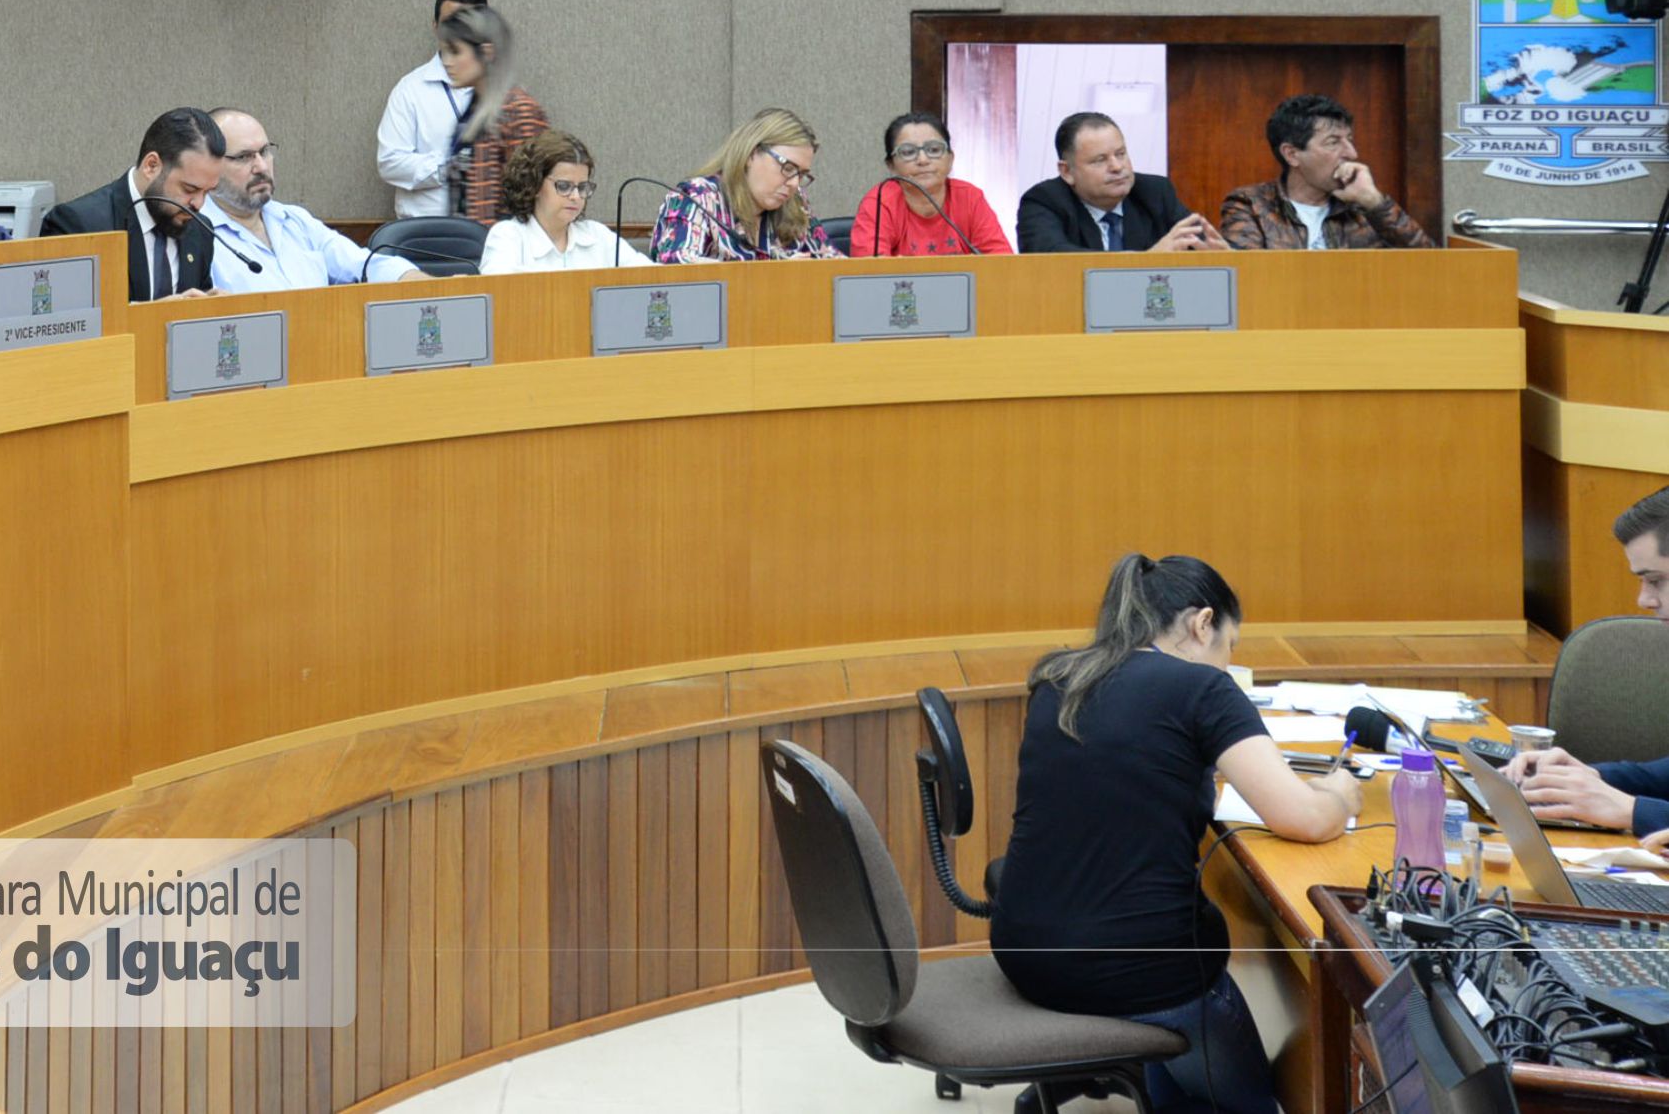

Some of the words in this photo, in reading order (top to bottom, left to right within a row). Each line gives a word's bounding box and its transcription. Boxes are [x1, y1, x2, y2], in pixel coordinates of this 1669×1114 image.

[1483, 109, 1523, 122] FOZ
[1531, 109, 1560, 122] DO
[1567, 109, 1651, 126] IGUAÇU
[1480, 138, 1549, 151] PARANÁ
[1591, 142, 1655, 152] BRASIL
[1498, 162, 1512, 174] 10
[1515, 167, 1531, 178] DE
[1535, 171, 1581, 182] JUNHO
[1585, 170, 1602, 181] DE
[1606, 164, 1636, 178] 1914
[14, 319, 87, 340] VICE-PRESIDENTE
